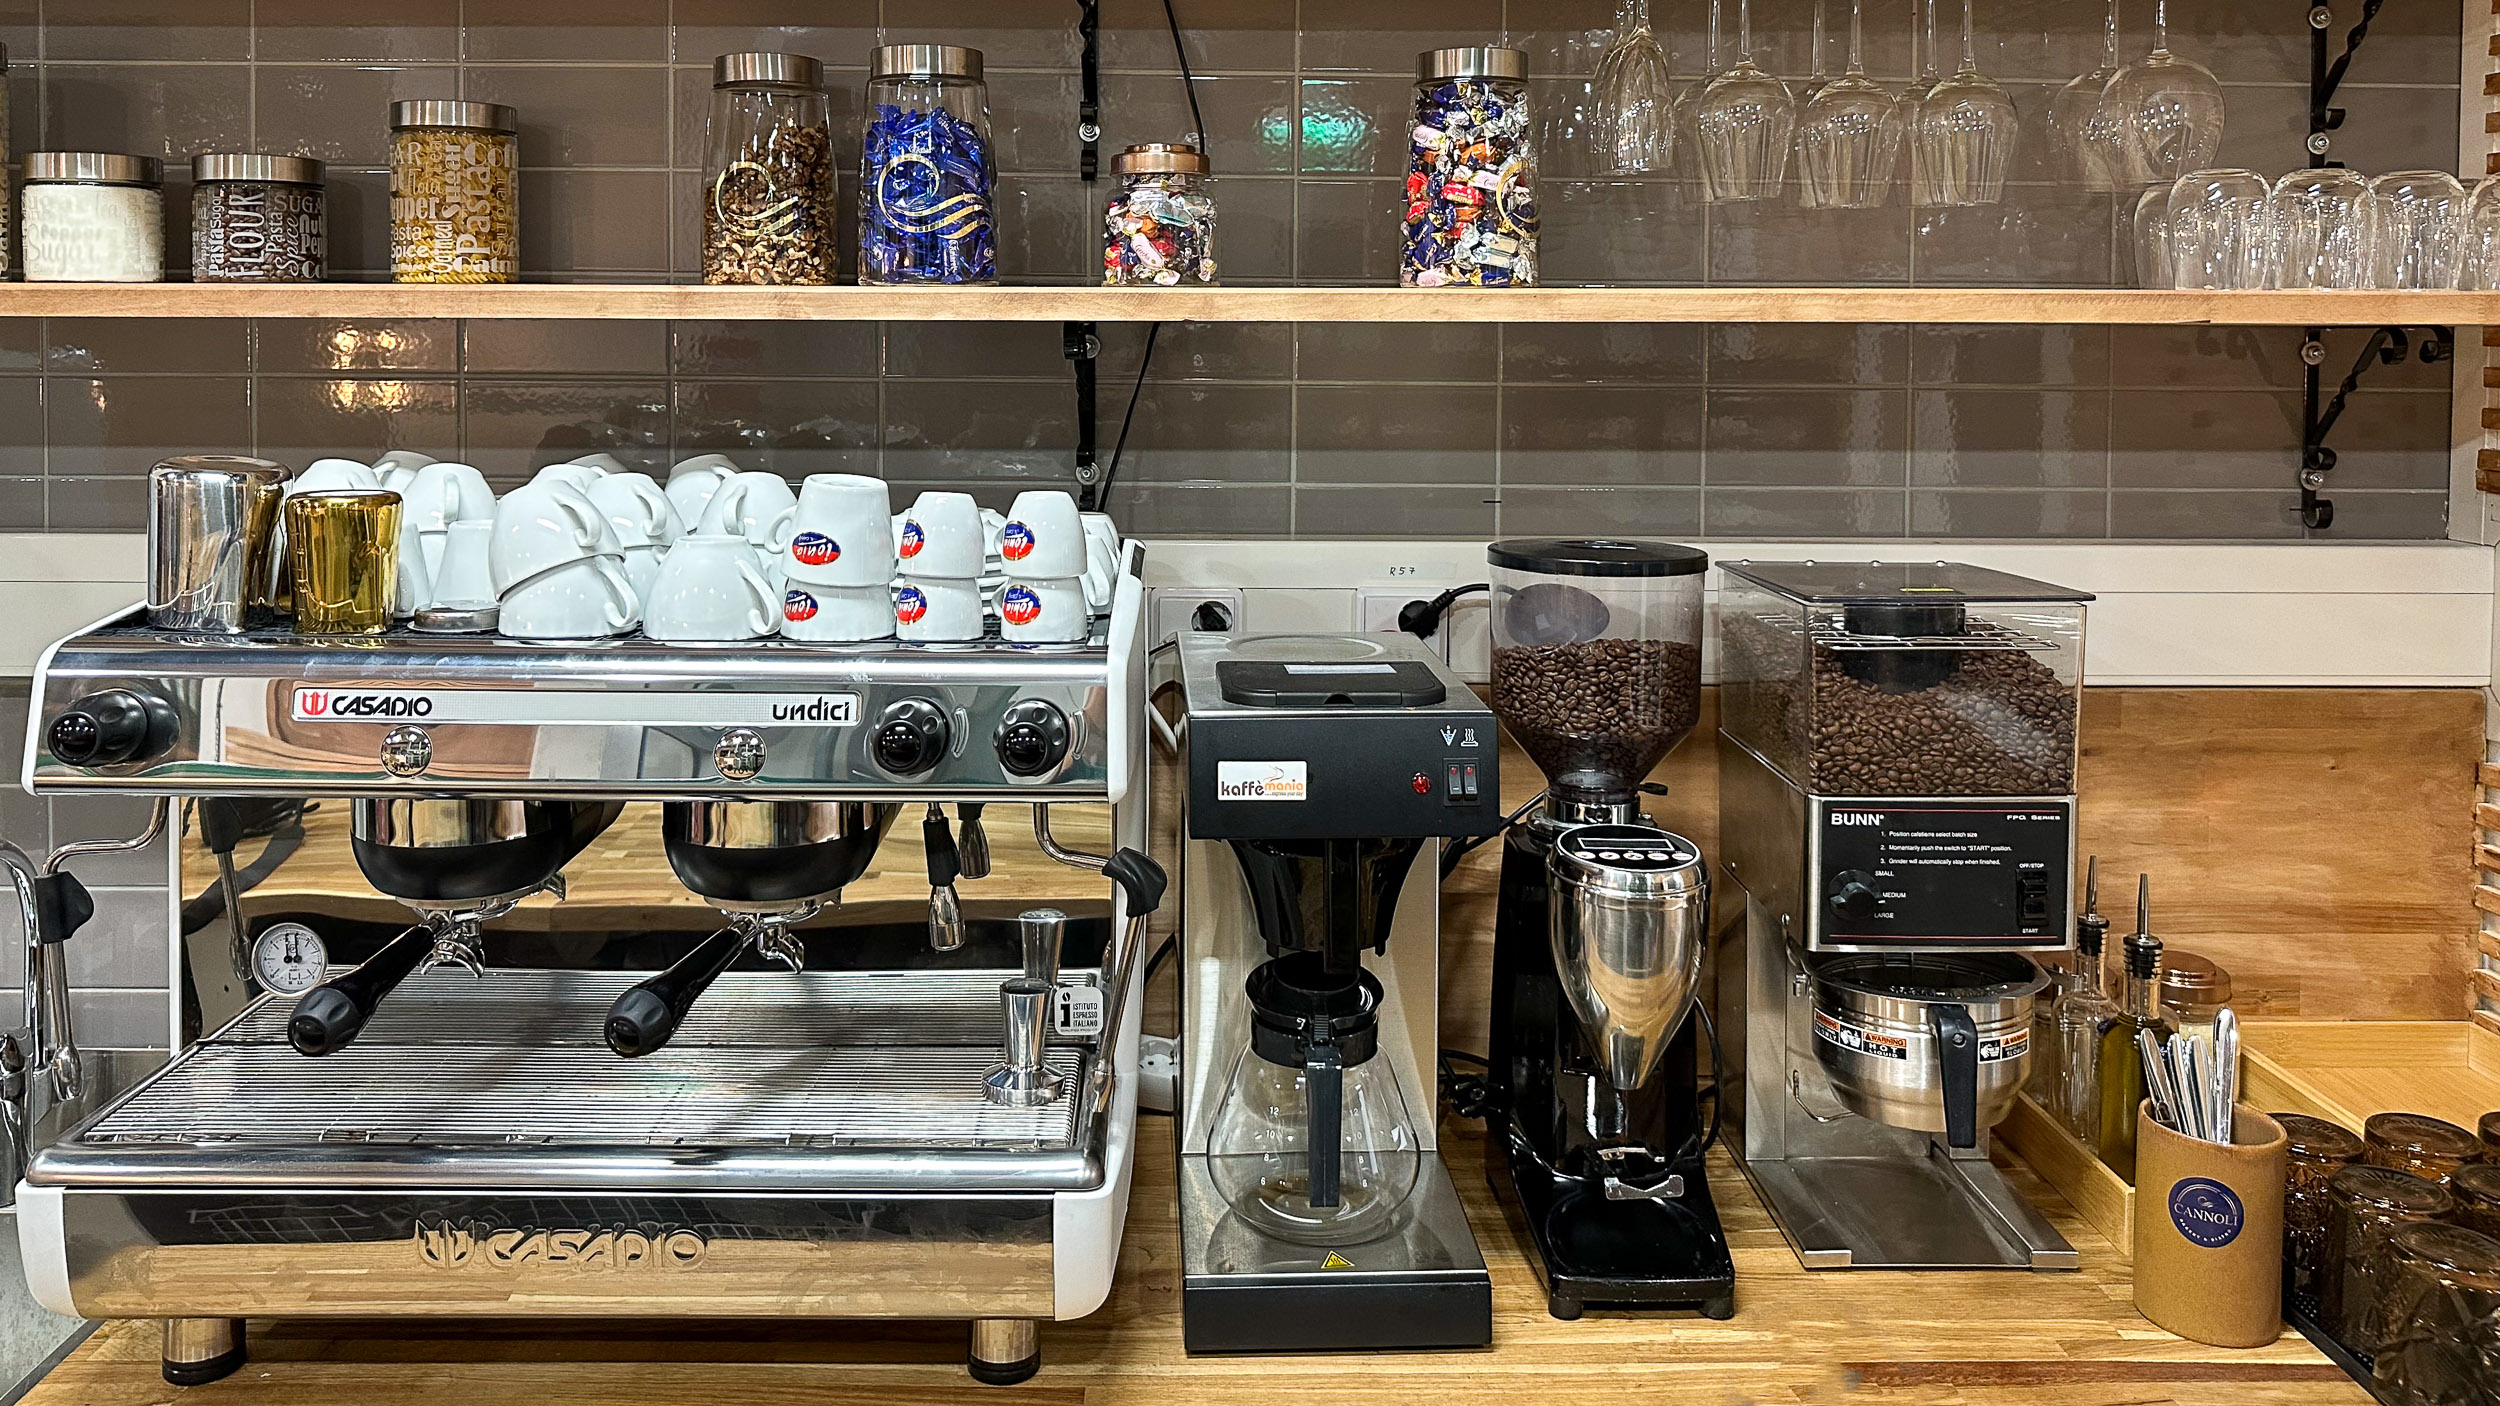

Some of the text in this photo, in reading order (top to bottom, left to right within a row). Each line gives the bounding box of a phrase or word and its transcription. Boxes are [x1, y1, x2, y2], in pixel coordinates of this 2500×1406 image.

[441, 140, 461, 219] Sugar
[455, 166, 491, 254] Pasta
[225, 192, 265, 278] FLOUR
[265, 212, 284, 252] Pasta
[391, 223, 422, 241] asta
[208, 229, 225, 277] Pasta
[273, 212, 306, 277] Spice
[426, 220, 454, 273] Oatmeal
[332, 696, 432, 717] CASADIO
[772, 695, 850, 721] undici
[1888, 830, 1910, 838] Position
[1888, 858, 1909, 866] Grinder
[1909, 858, 1918, 866] will
[1918, 858, 1952, 867] automatically
[1072, 1002, 1098, 1010] ISTITUTO
[1072, 1011, 1098, 1019] ESPRESSO
[1868, 1042, 1899, 1054] HOT
[1870, 1033, 1904, 1047] WARNING
[1269, 1106, 1279, 1117] 12
[1266, 1130, 1275, 1139] 10
[2174, 1202, 2238, 1226] CANNOLI
[485, 1228, 706, 1269] CASADIO
